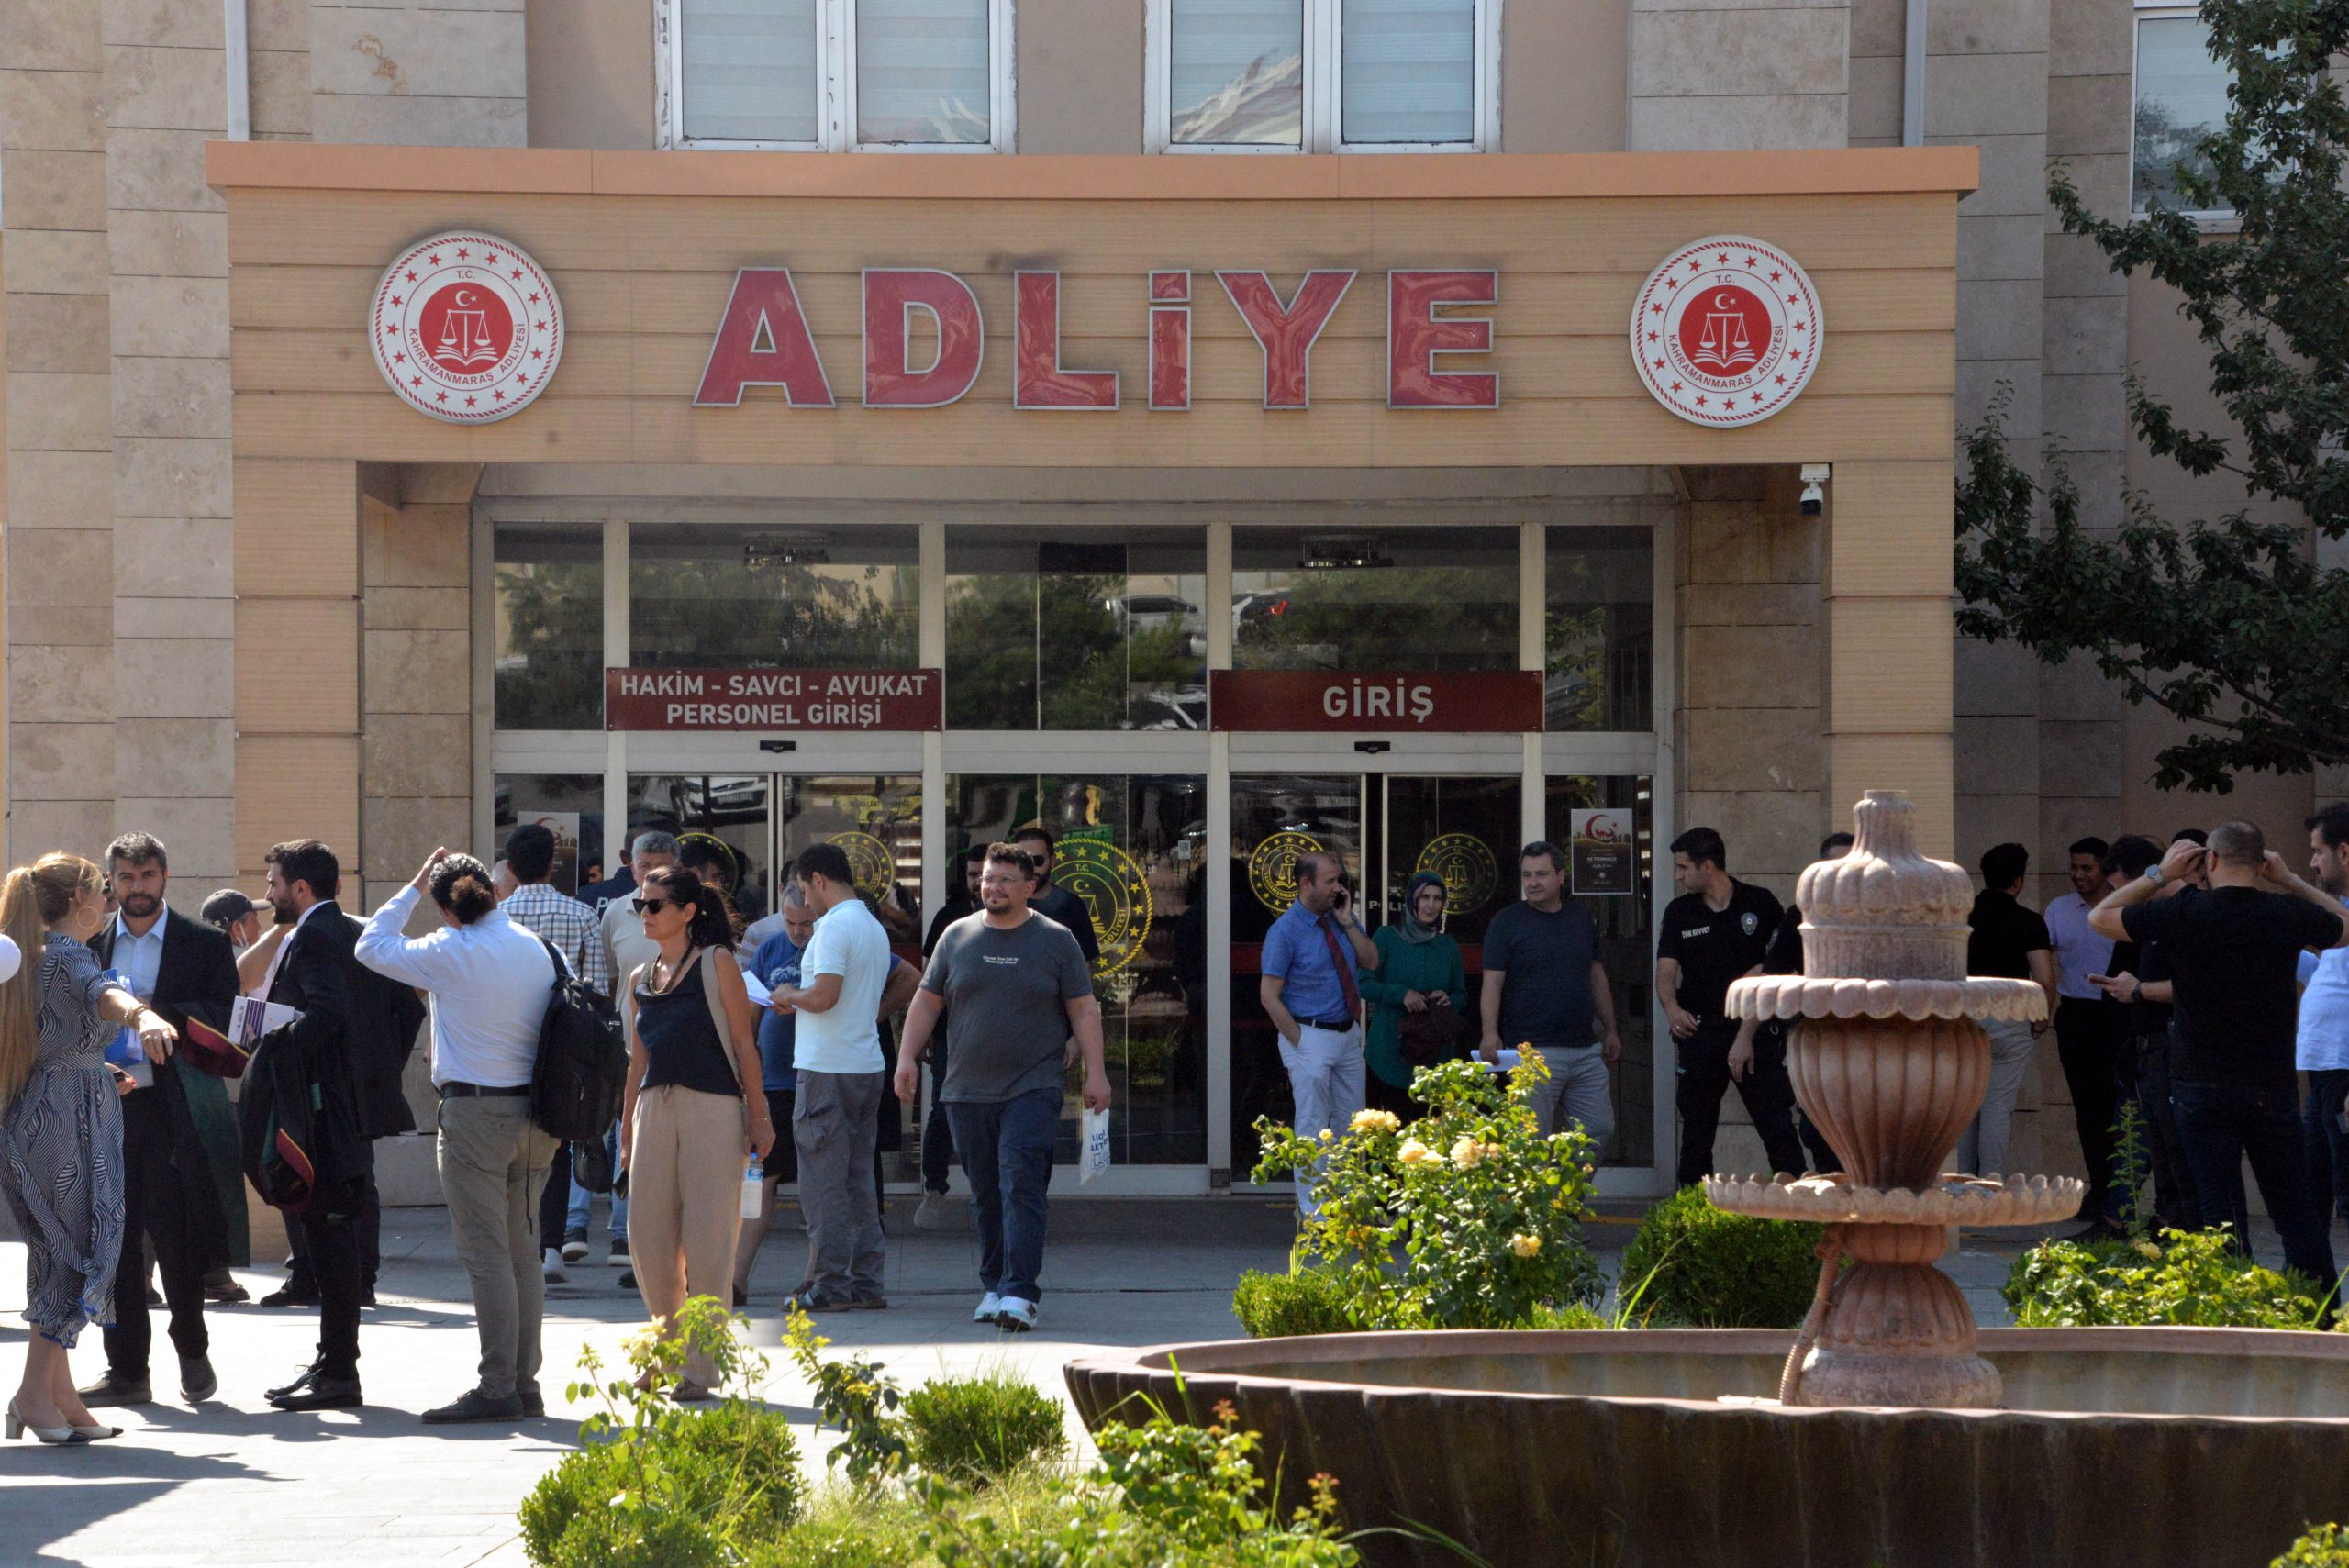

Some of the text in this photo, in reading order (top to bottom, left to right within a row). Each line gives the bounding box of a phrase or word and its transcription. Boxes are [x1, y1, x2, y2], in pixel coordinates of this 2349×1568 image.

[456, 270, 476, 279] T.C.
[1715, 274, 1735, 284] T.C.
[409, 323, 526, 385] KAHRAMANMARAŞ ADLİYESİ
[692, 266, 1499, 410] ADLİYE
[1668, 325, 1784, 388] KAHRAMANMARAŞ ADLİYESİ
[621, 670, 704, 696] HAKİM
[729, 675, 801, 696] SAVCI
[827, 675, 928, 696] AVUKAT
[1323, 678, 1434, 723] GİRİŞ
[667, 698, 881, 728] PERSONEL GİRİŞİ
[1104, 909, 1127, 946] ADLİYESİ
